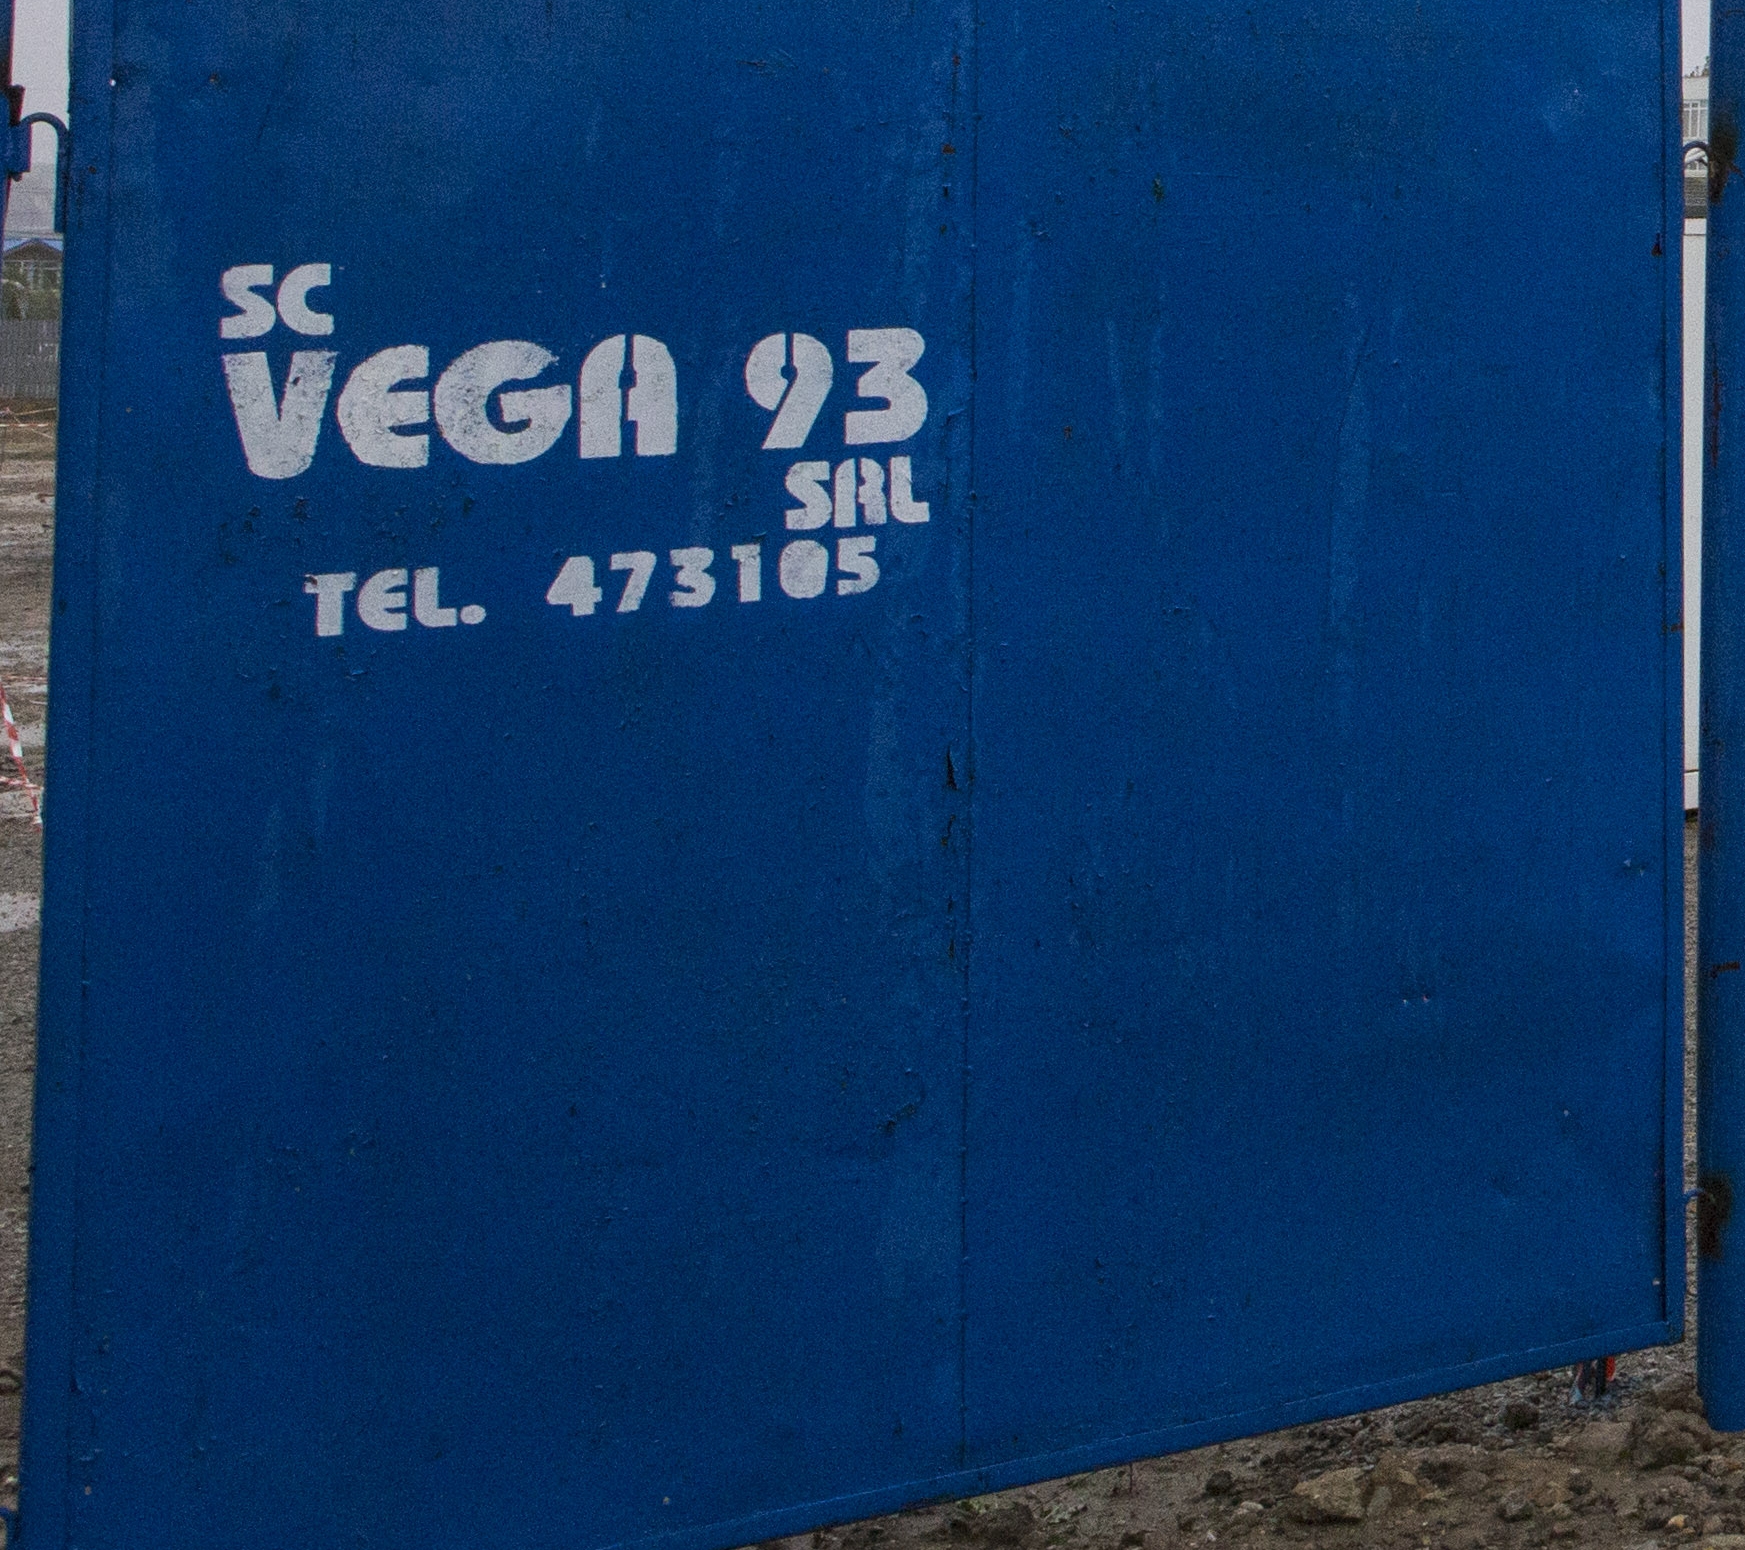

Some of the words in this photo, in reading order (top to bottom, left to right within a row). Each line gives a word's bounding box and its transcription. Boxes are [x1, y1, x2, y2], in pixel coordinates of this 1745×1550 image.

[220, 263, 334, 339] SC
[222, 334, 678, 480] VEGA
[745, 327, 929, 450] 93
[785, 456, 930, 530] SRL
[304, 566, 486, 637] TEL.
[546, 536, 881, 617] 473105
